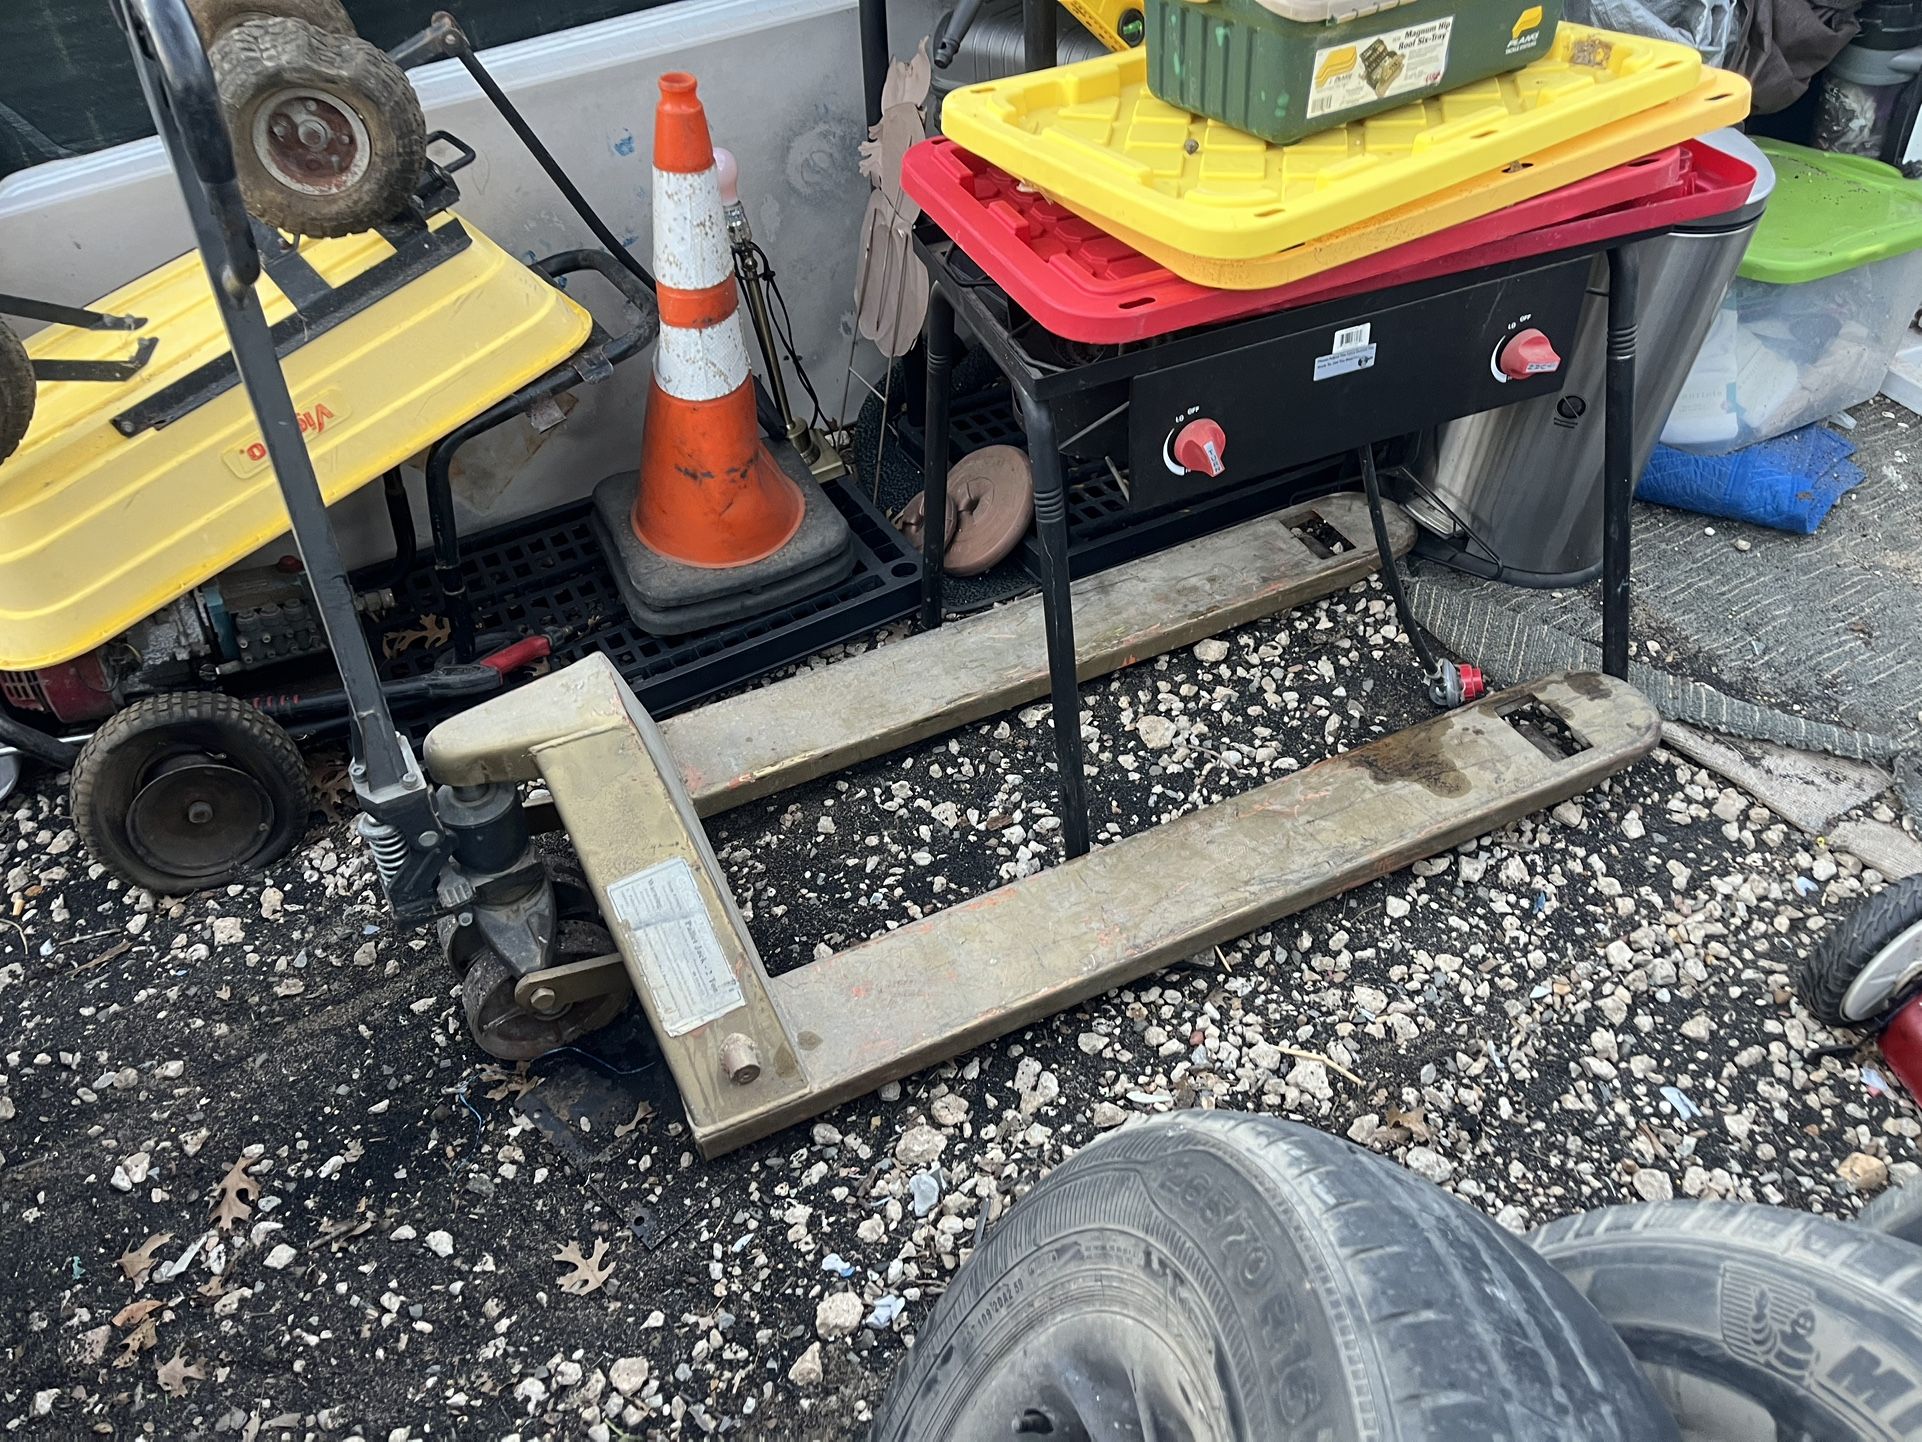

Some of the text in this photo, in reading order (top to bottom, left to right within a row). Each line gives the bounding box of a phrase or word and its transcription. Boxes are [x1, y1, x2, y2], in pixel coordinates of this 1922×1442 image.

[1404, 25, 1437, 40] Magnum
[1438, 21, 1451, 32] Hip
[1398, 38, 1417, 50] Roof
[1519, 313, 1532, 323] OFF
[1175, 405, 1200, 423] LO OFF
